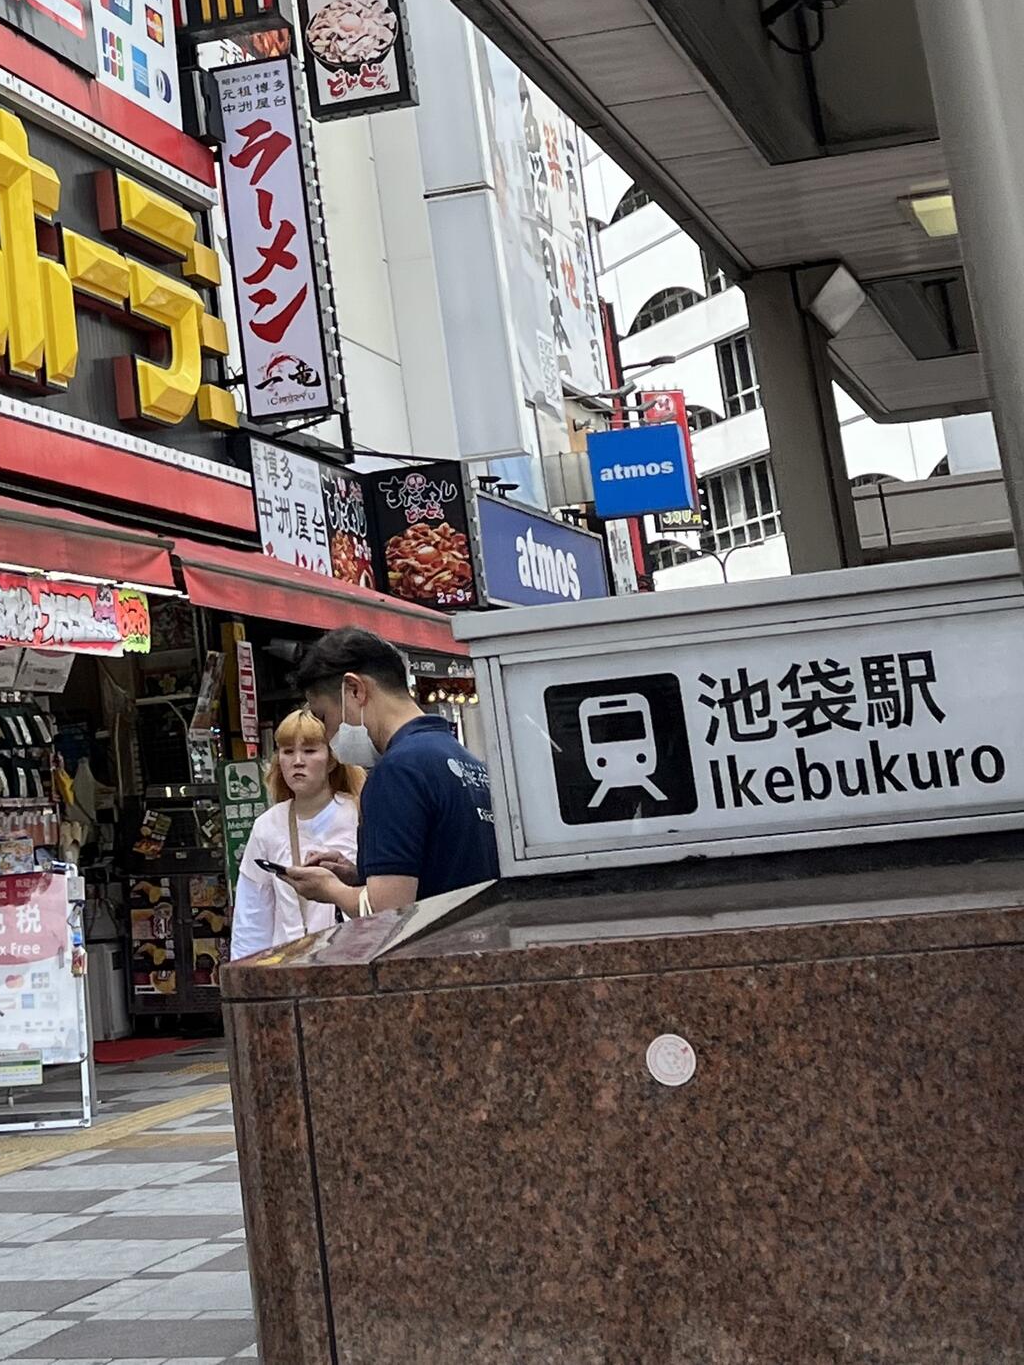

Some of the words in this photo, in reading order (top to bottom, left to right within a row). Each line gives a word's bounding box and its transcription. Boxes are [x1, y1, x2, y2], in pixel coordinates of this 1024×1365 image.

[103, 45, 123, 67] JCB
[221, 79, 286, 101] 元祖博多
[327, 64, 391, 100] どんどん
[221, 95, 287, 115] 中洲屋台
[229, 119, 308, 343] ラーメン
[600, 460, 674, 482] atmos
[258, 490, 328, 548] 中洲屋台
[516, 527, 581, 601] atmos
[695, 650, 946, 747] 池袋駅
[709, 739, 1006, 810] Ikebukuro
[10, 942, 41, 955] Free
